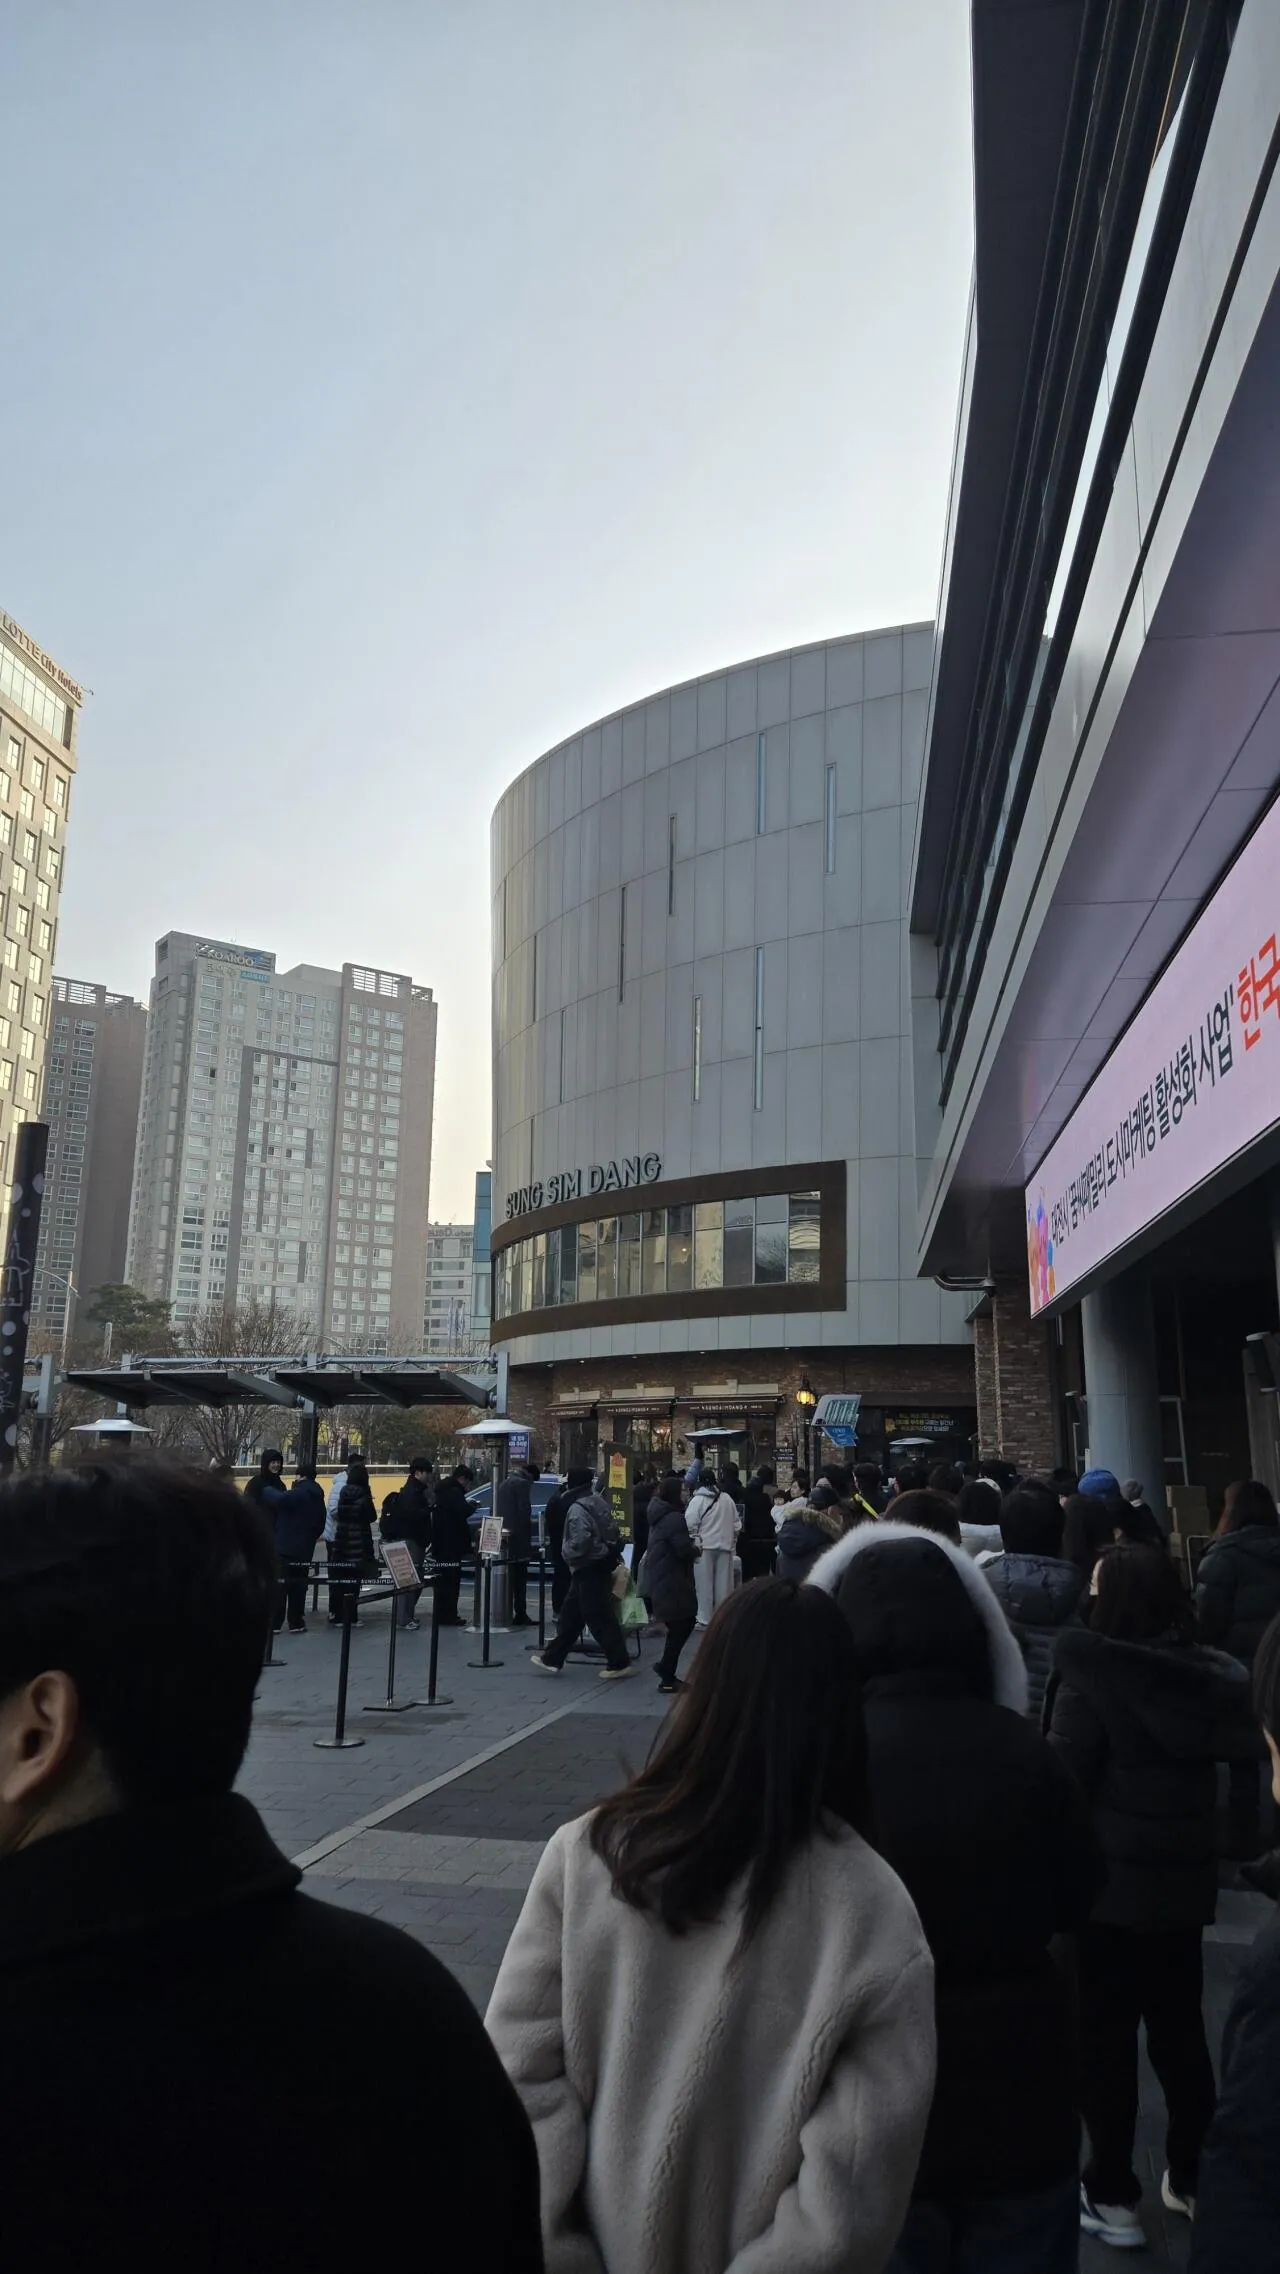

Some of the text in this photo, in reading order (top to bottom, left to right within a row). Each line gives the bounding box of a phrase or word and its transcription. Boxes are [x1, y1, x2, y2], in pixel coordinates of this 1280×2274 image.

[3, 614, 41, 660] LOTTE
[41, 653, 58, 677] City
[1051, 1190, 1069, 1248] 대전시
[1106, 1084, 1155, 1187] 도시마케팅
[1155, 1034, 1197, 1140] 활성화
[505, 1152, 662, 1219] SUNG SIM DANG
